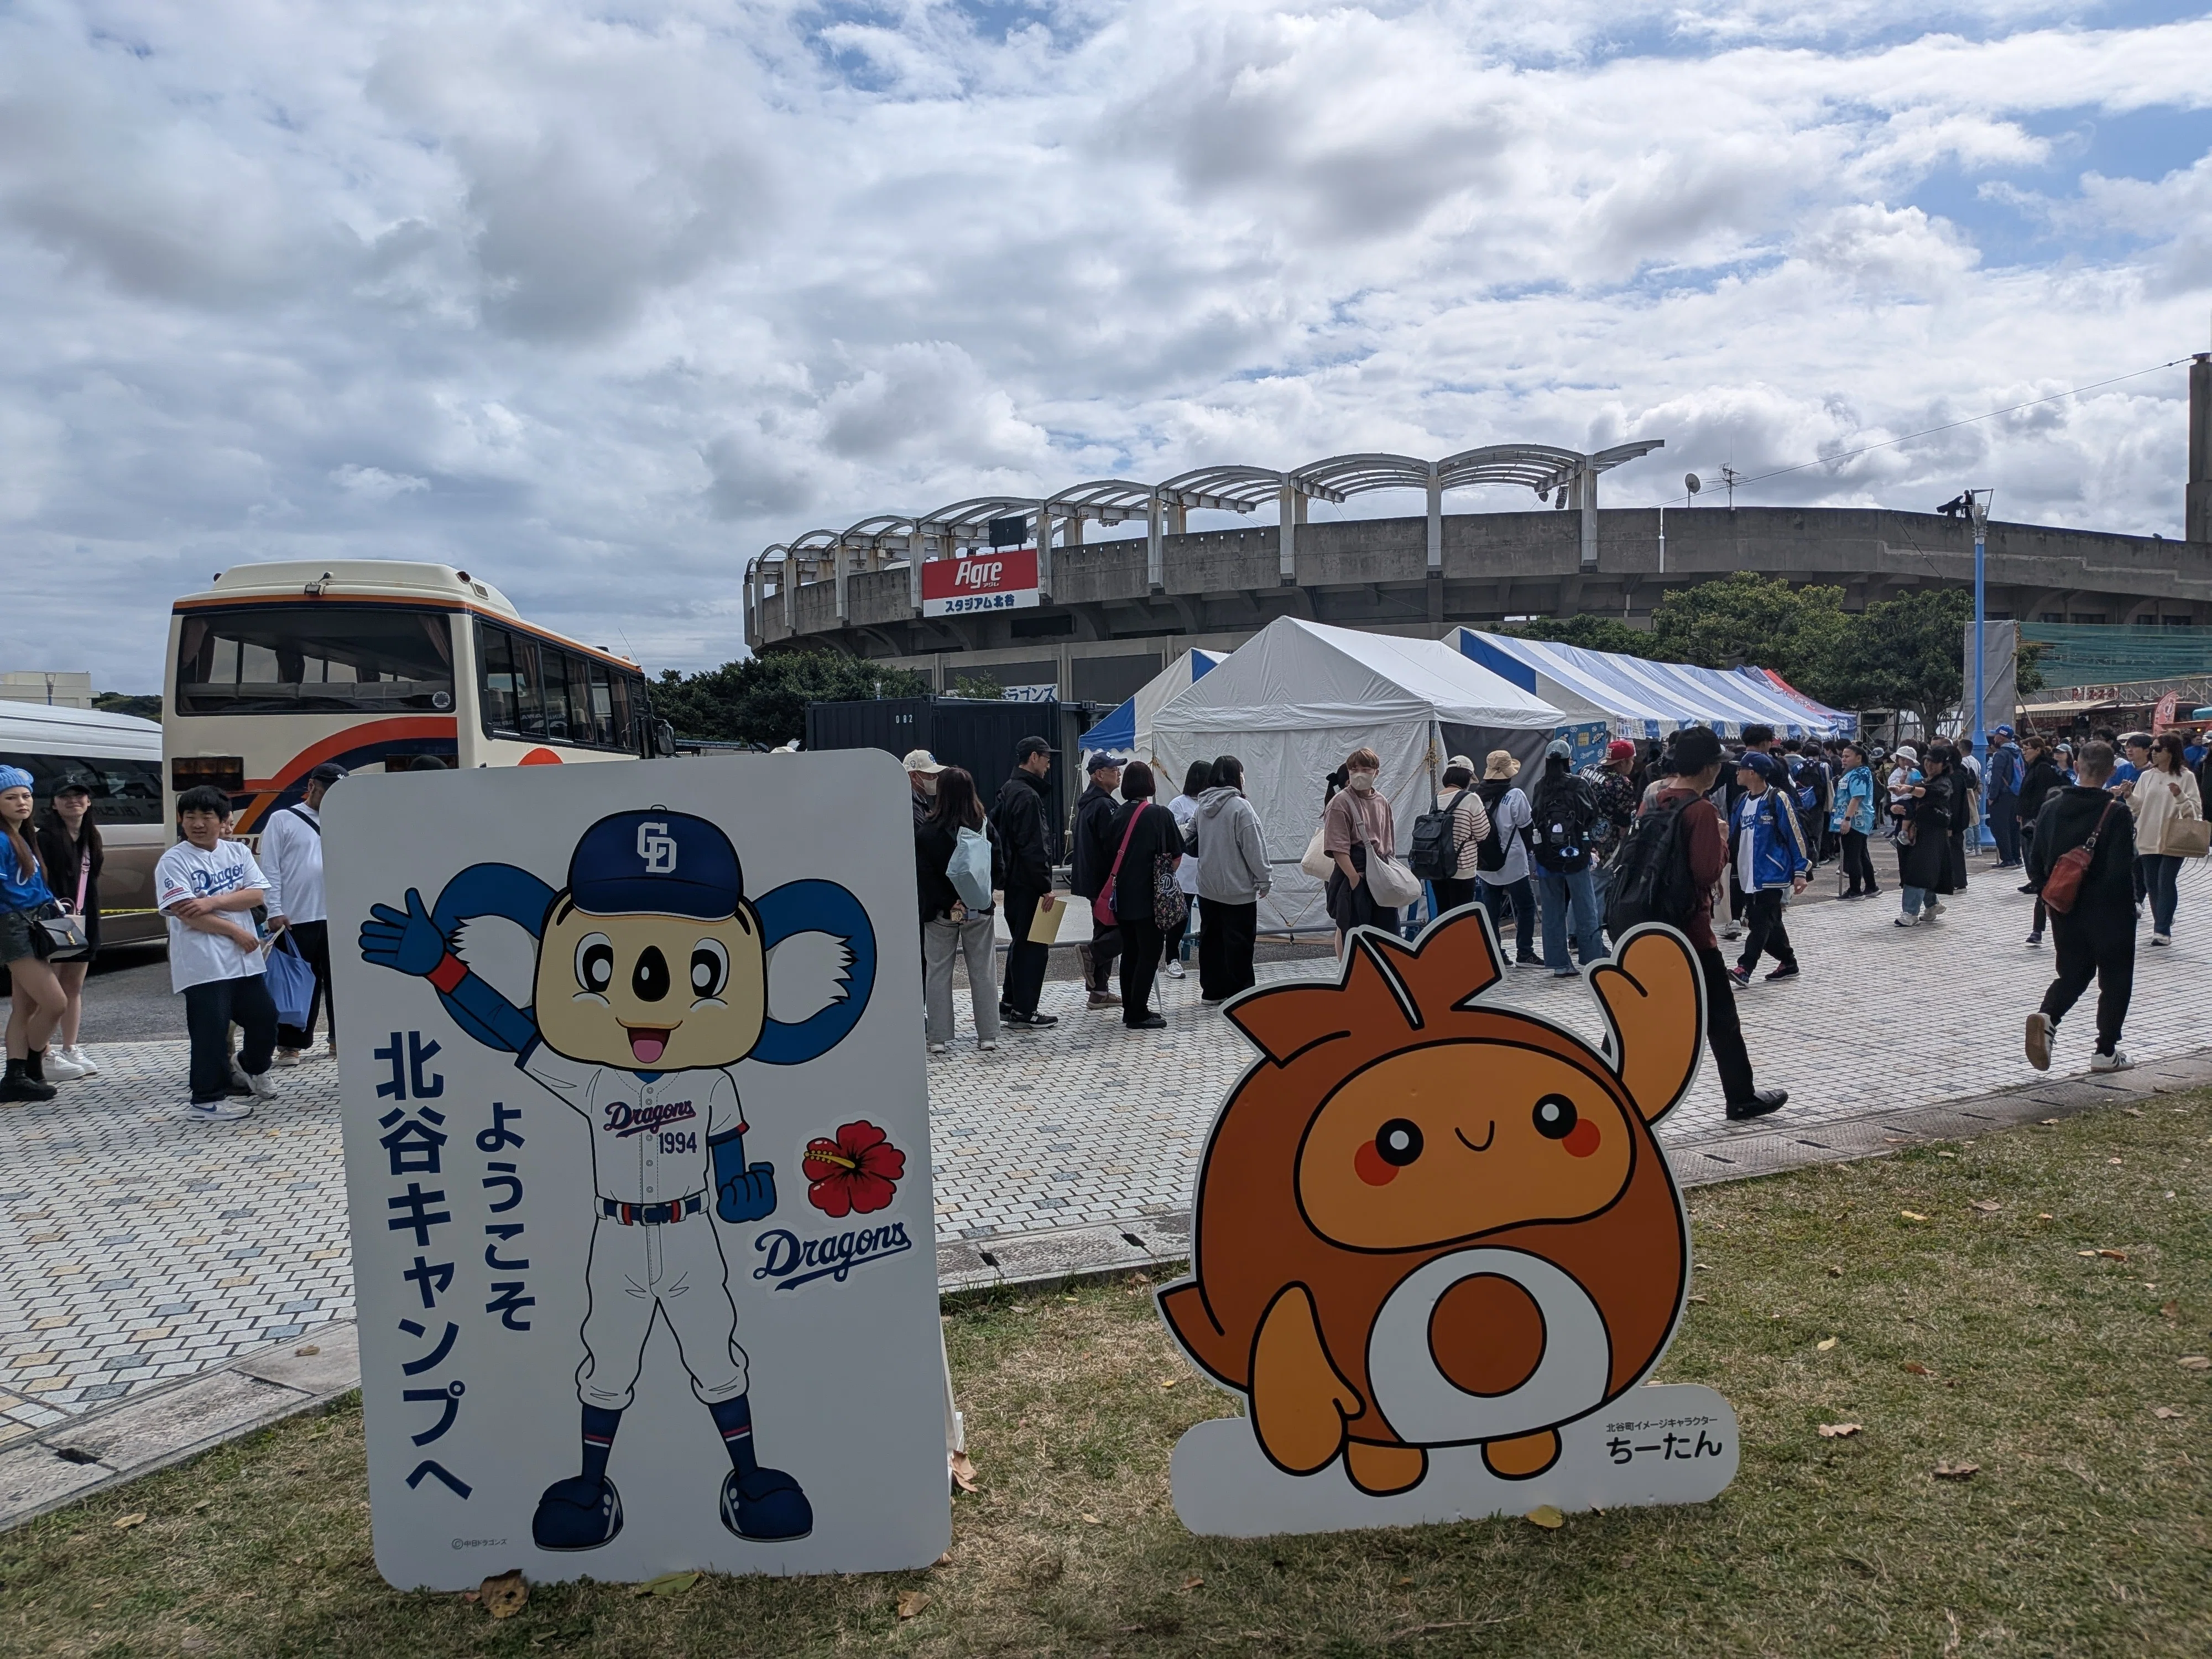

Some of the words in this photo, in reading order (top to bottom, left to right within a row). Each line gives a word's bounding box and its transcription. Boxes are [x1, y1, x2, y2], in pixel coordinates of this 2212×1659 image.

[955, 560, 1003, 589] Agre
[945, 593, 1015, 613] スタジアム北谷
[1002, 685, 1057, 702] ラゴンズ
[1581, 768, 1606, 785] TANAKA
[191, 863, 243, 896] Dragon
[603, 1100, 697, 1139] Dragons
[659, 1131, 697, 1154] 1994
[476, 1102, 536, 1332] ようこそ
[374, 1030, 473, 1500] 北谷キャンプへ
[753, 1222, 912, 1292] Dragons
[1606, 1416, 1718, 1432] 北谷町イメージキャラクター
[1606, 1430, 1723, 1464] ちーたん
